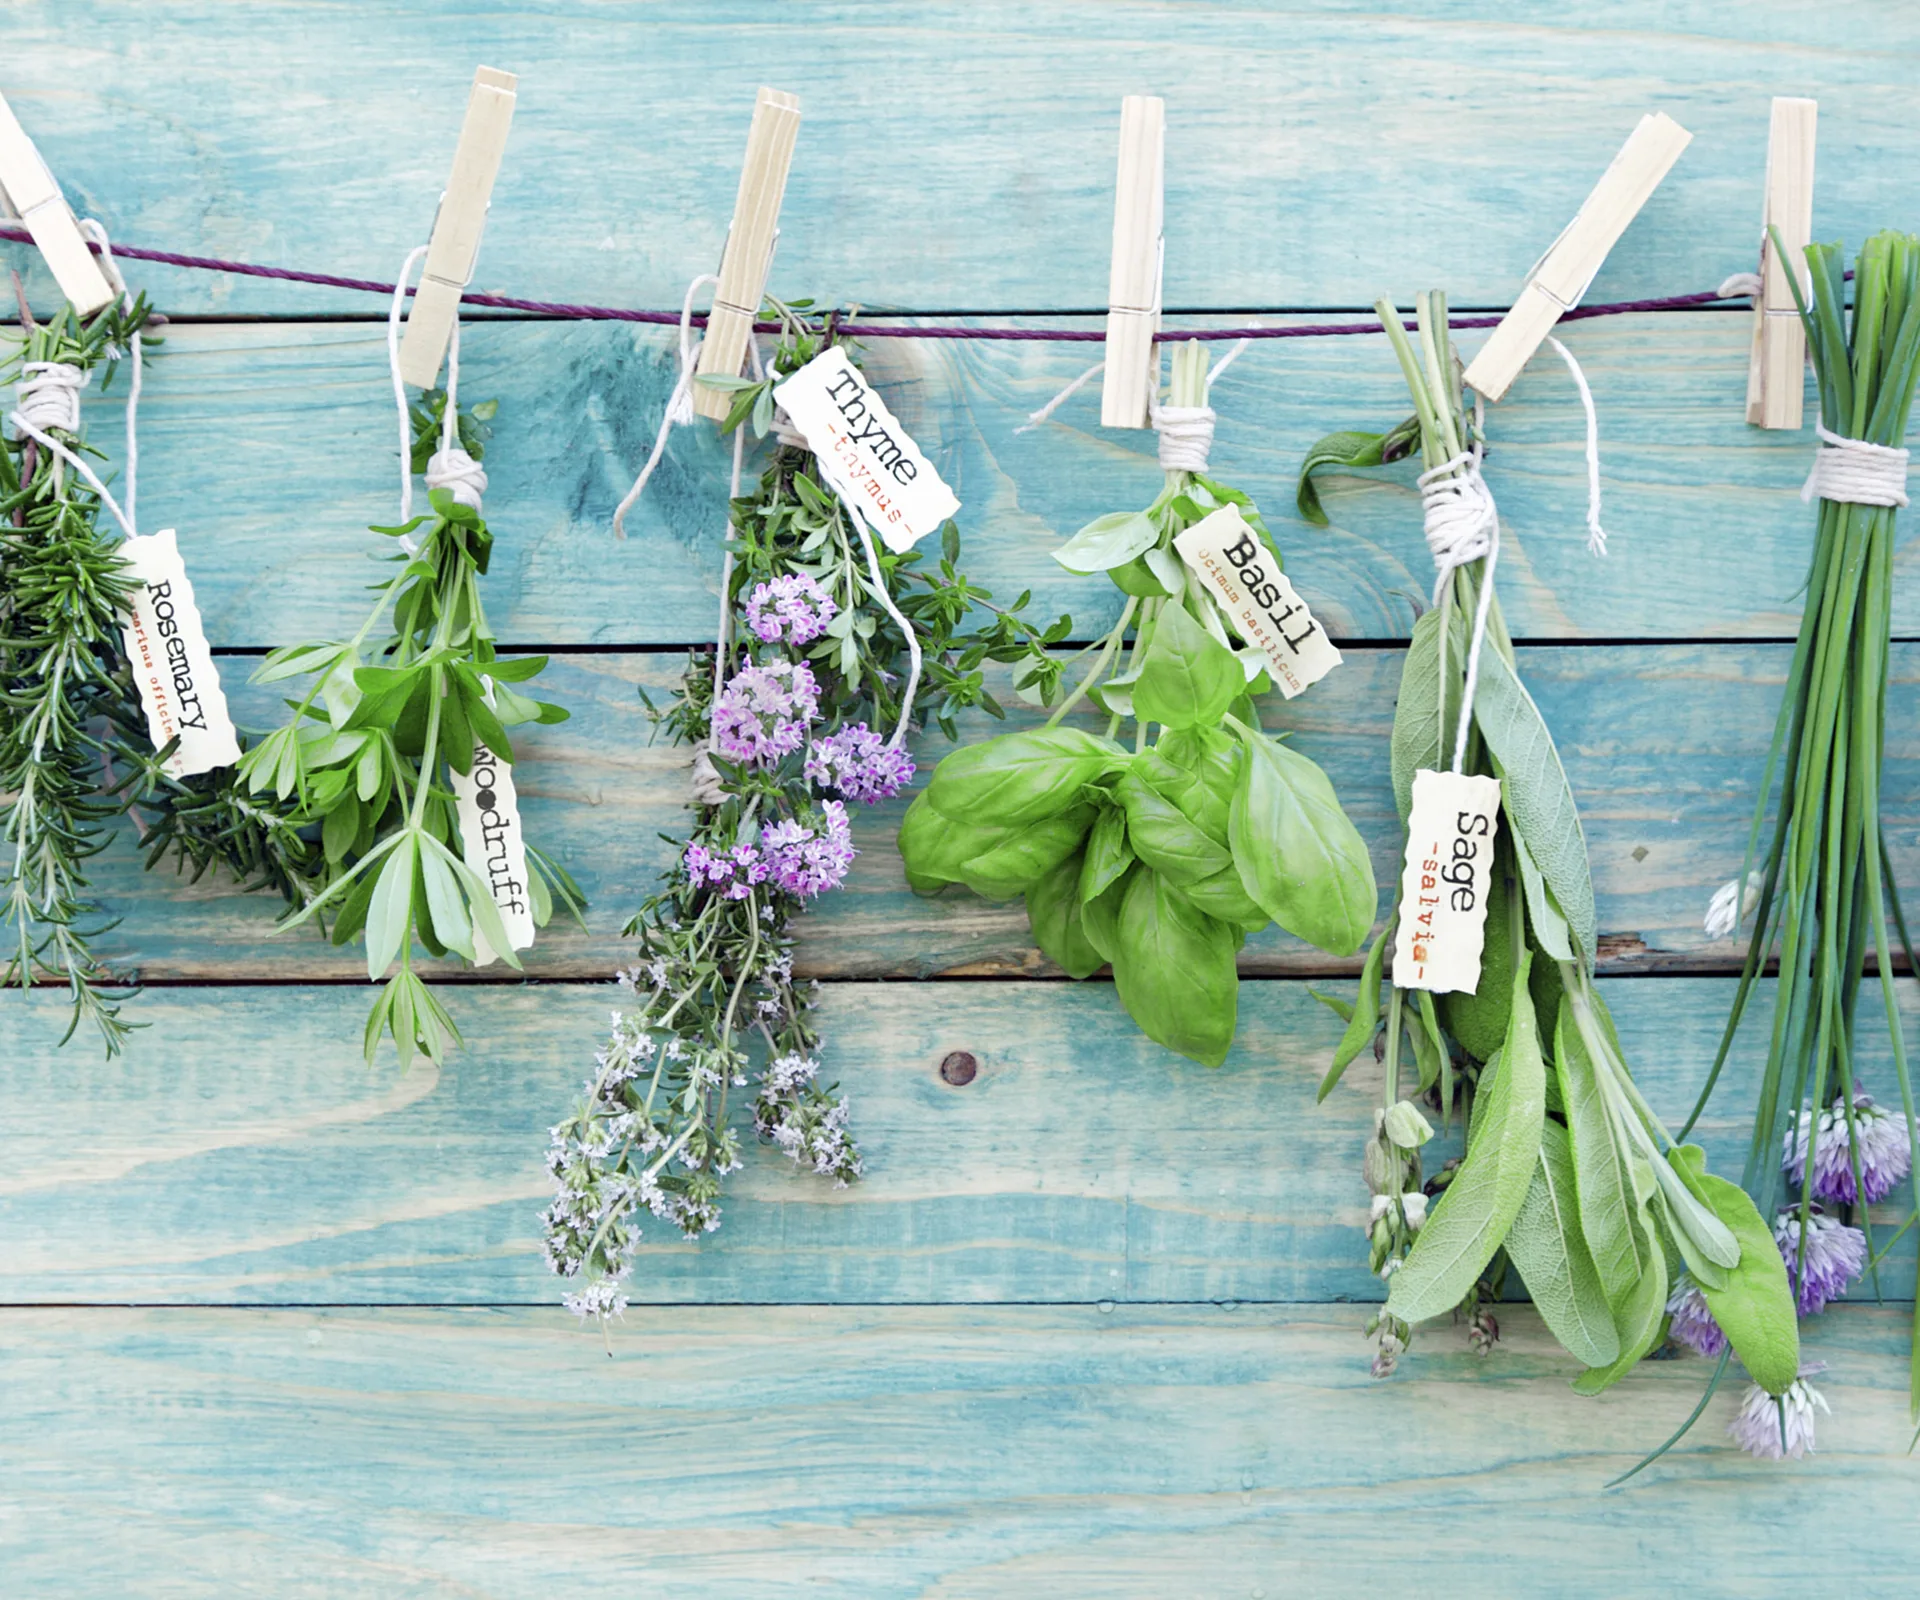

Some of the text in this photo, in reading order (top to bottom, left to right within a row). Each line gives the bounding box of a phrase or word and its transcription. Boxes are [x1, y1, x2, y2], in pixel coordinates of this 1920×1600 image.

[825, 368, 918, 486] Thyme
[1198, 548, 1300, 691] Ocimum basilicum
[1222, 530, 1316, 655] Basil
[147, 579, 208, 731] Rosemary
[150, 677, 184, 774] officinais-
[1441, 811, 1489, 912] Sage
